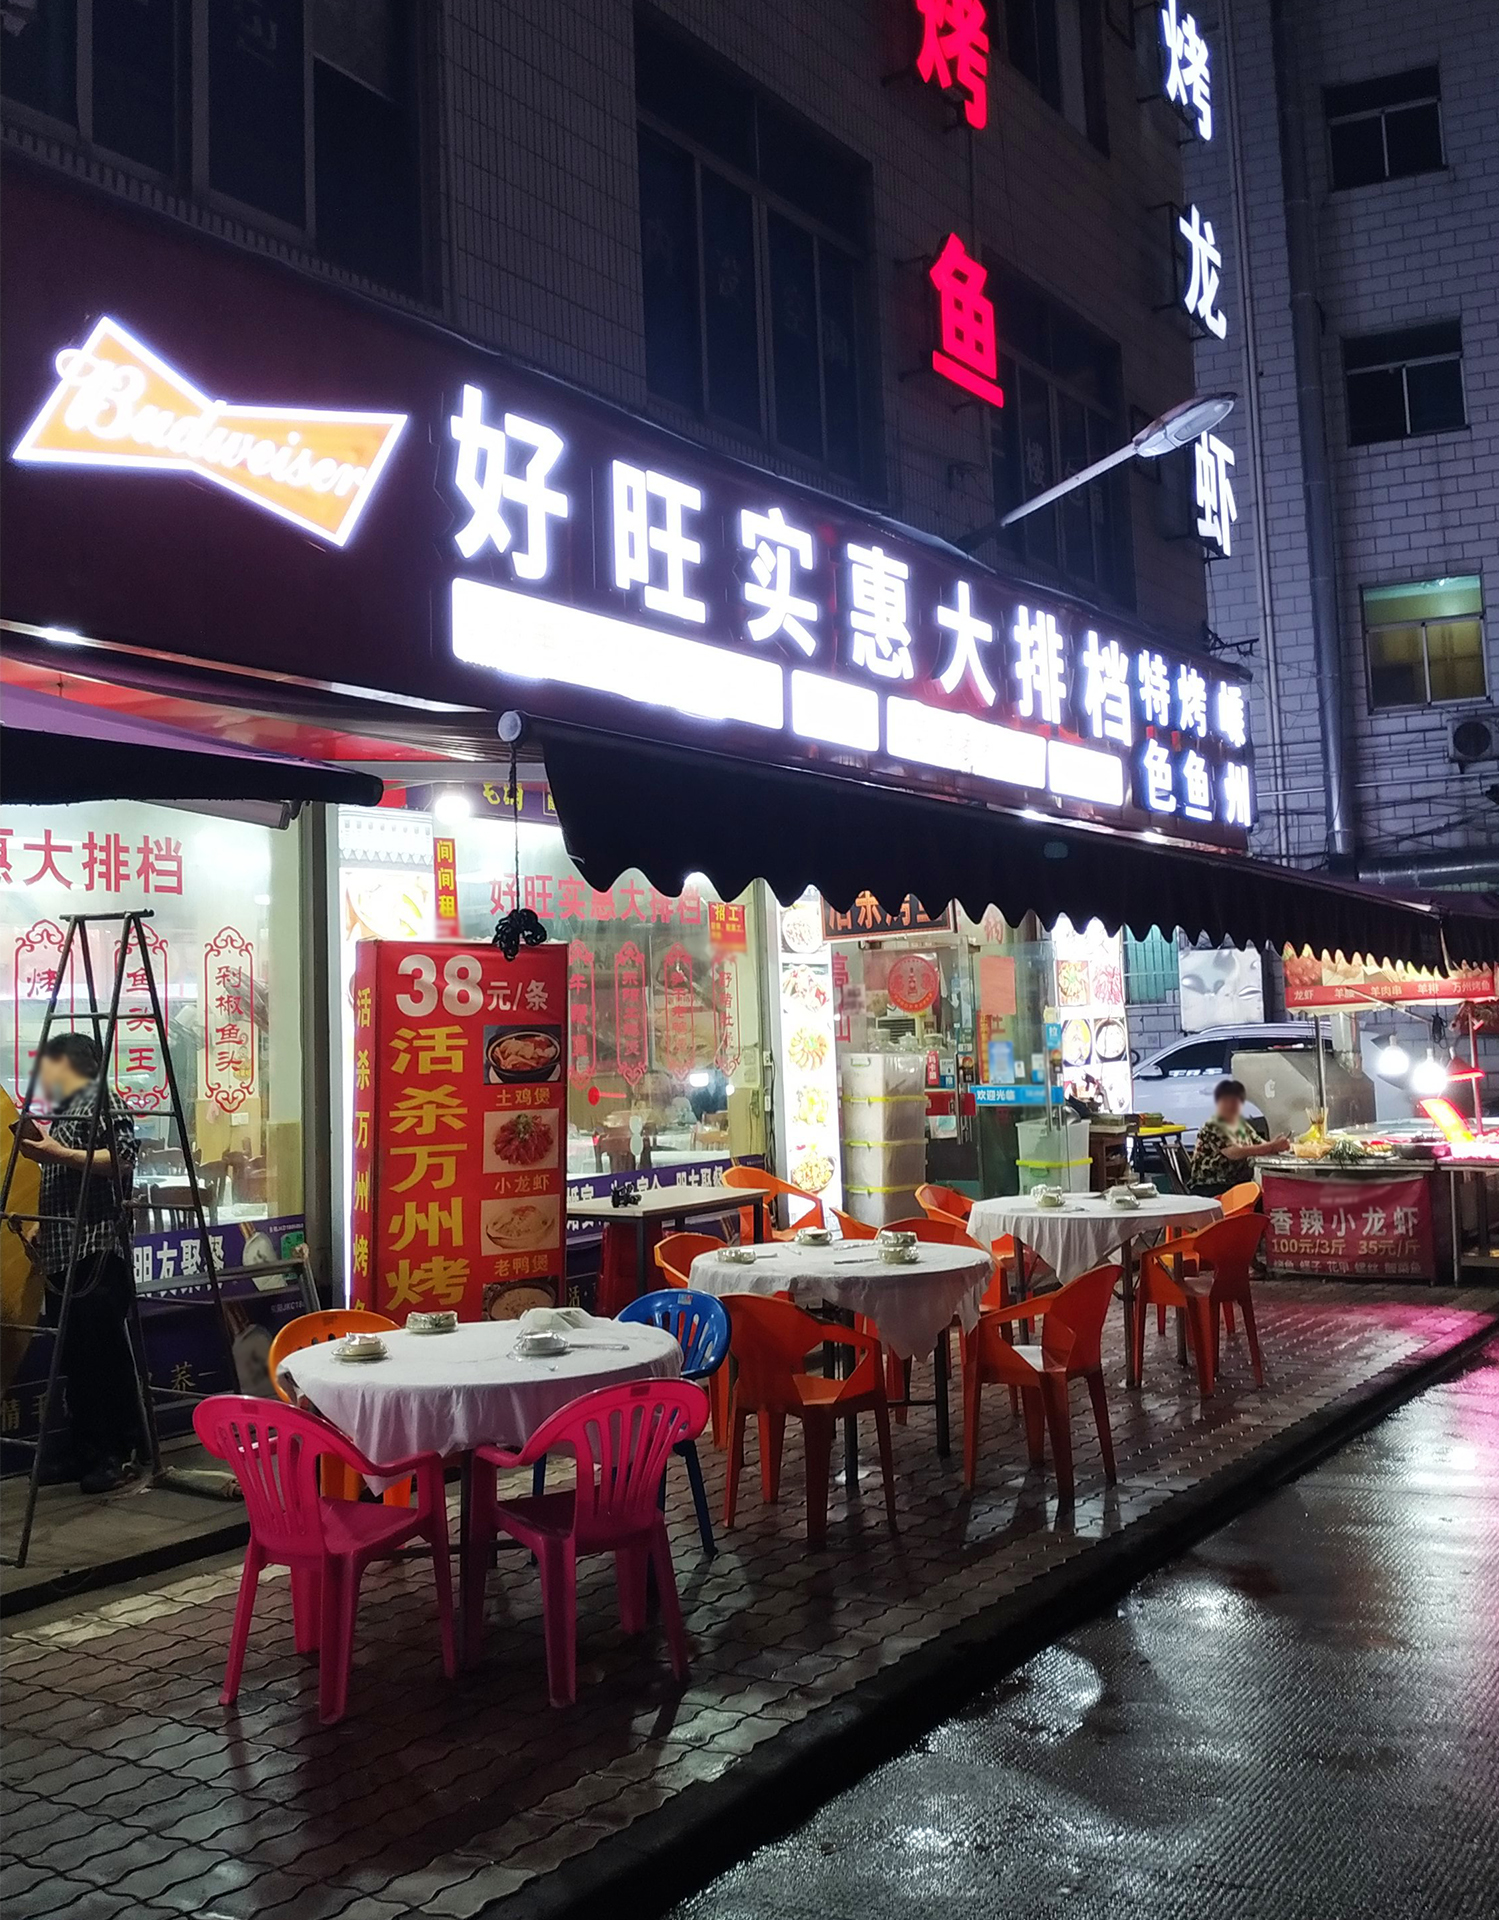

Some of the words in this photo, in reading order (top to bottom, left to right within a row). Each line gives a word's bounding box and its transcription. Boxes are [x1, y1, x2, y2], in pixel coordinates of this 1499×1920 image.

[916, 0, 1005, 408] 烤鱼
[1161, 0, 1239, 557] 烤龙虾
[55, 347, 366, 496] Budweiser
[450, 383, 1132, 747] 好旺实惠大排档
[396, 954, 548, 1017] 38元/条
[496, 1088, 550, 1107] 土鸡煲
[976, 1089, 1016, 1102] 欢迎光临
[495, 1174, 550, 1194] 小龙虾
[1269, 1206, 1419, 1237] 香辣小龙虾
[494, 1254, 549, 1278] 老鸭煲
